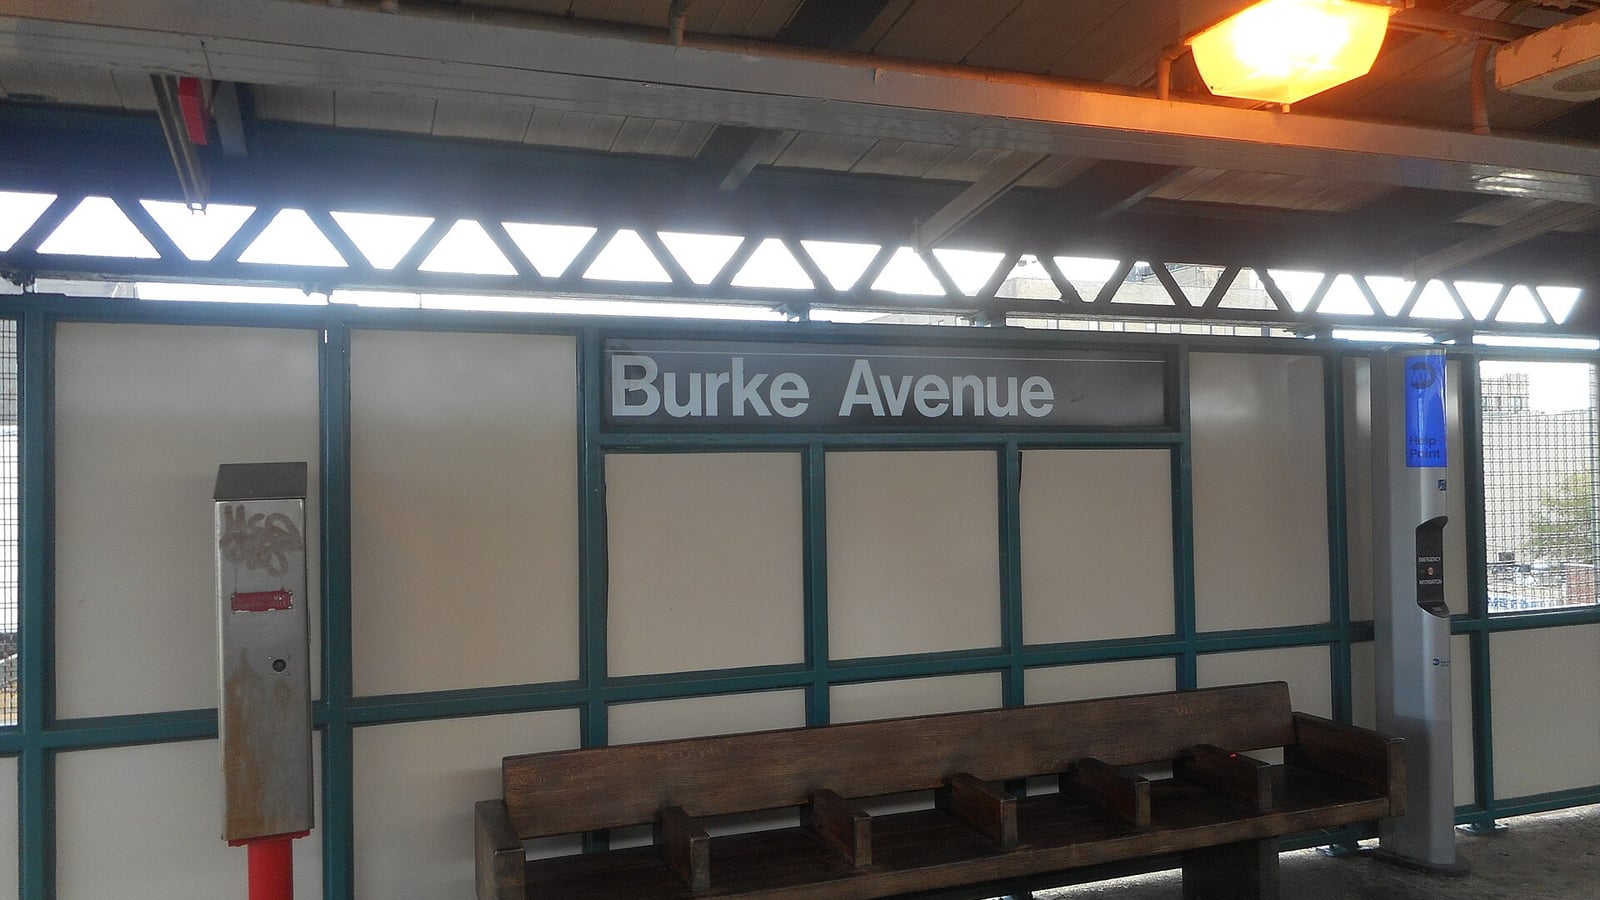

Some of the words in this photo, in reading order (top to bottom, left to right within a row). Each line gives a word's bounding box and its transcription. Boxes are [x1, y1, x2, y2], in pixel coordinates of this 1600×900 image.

[611, 355, 810, 417] Burke
[838, 359, 1054, 418] Avenue
[1409, 436, 1436, 447] Help
[1409, 449, 1440, 458] Point
